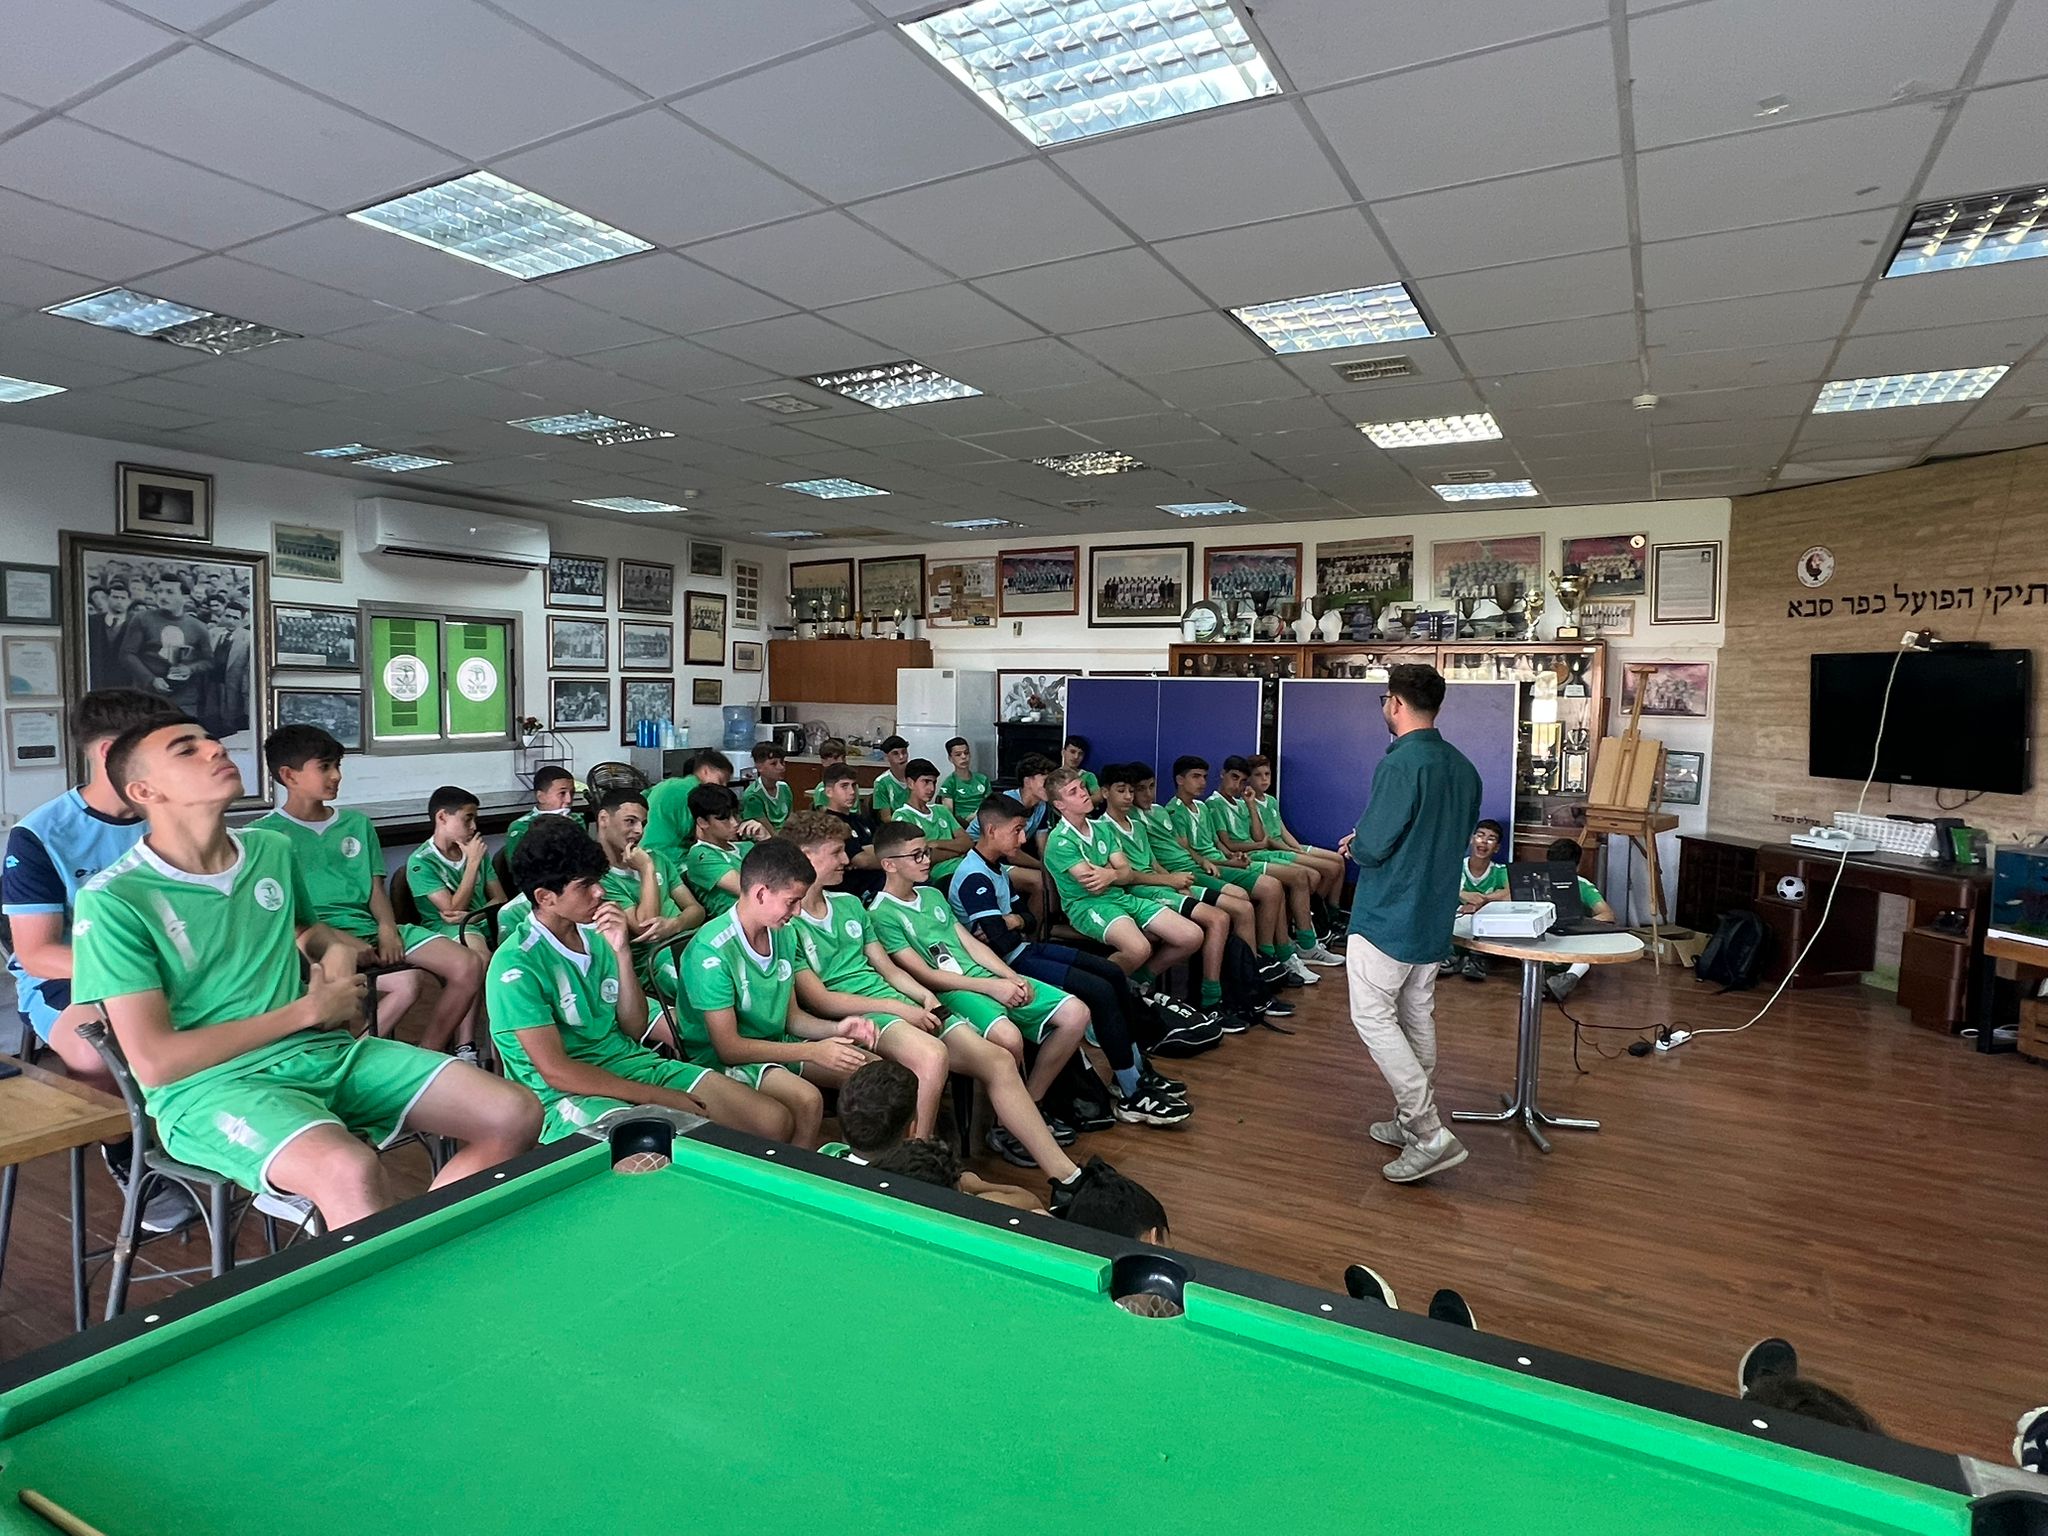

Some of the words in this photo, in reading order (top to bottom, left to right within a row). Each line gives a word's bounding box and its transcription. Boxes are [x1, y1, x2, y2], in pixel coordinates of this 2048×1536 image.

[1787, 598, 1834, 618] סבא
[1841, 595, 1886, 615] כפר
[1893, 584, 1974, 616] הפועל
[1136, 1096, 1160, 1112] N
